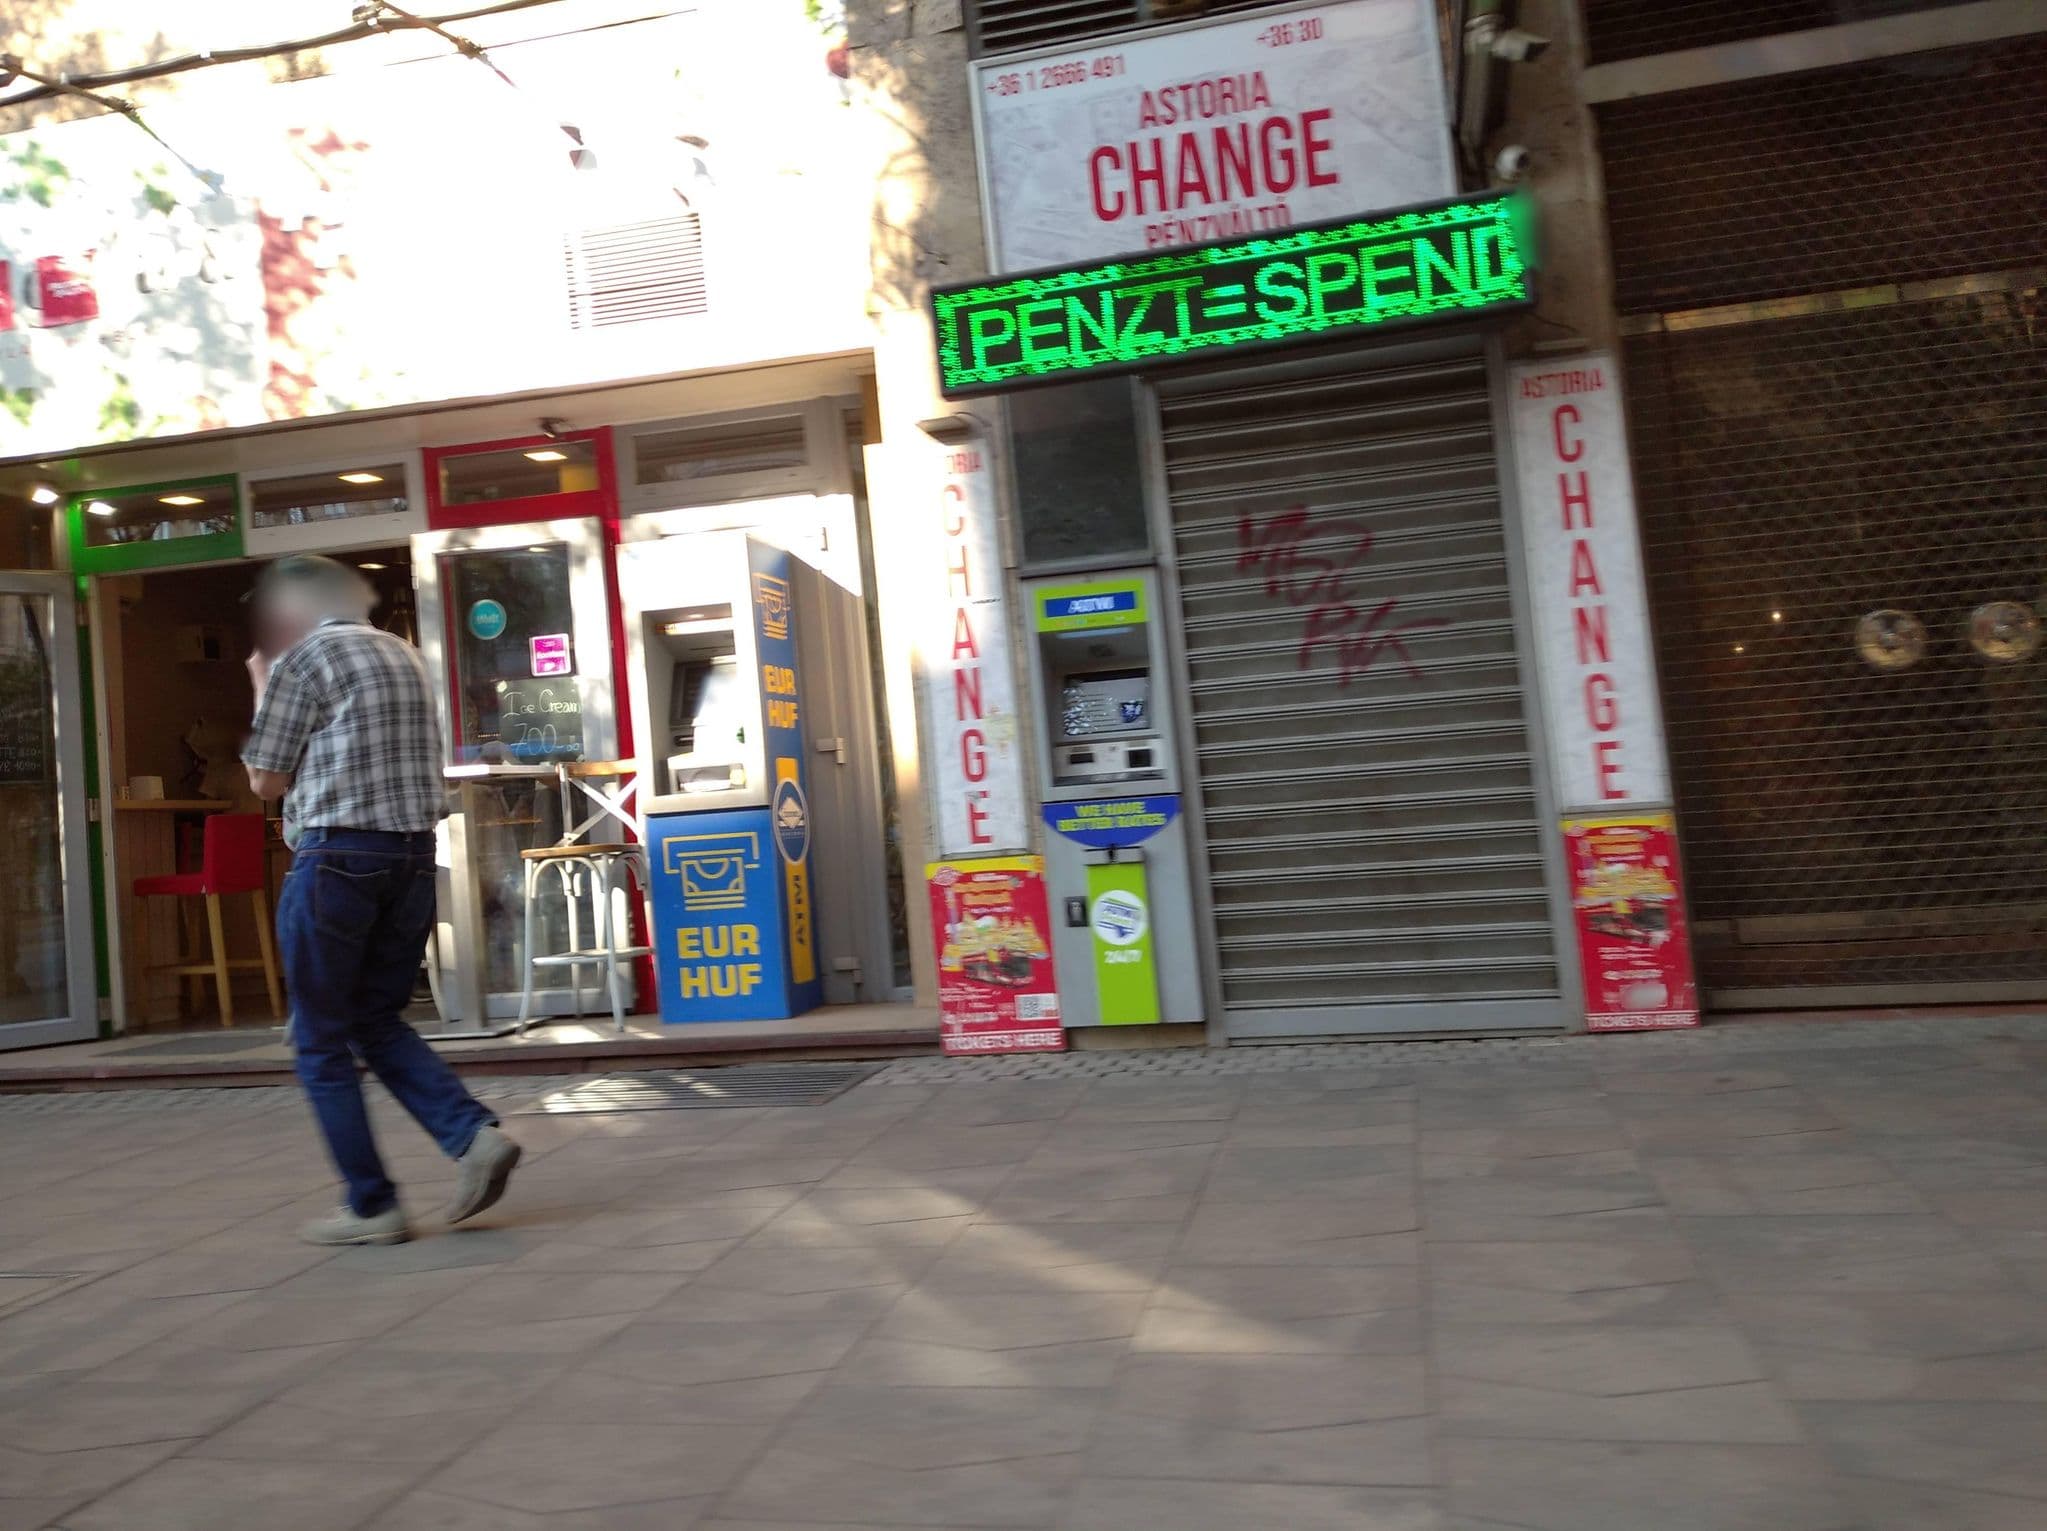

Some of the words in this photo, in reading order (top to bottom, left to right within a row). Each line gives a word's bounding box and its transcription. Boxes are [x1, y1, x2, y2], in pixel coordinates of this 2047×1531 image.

[1026, 70, 1037, 90] 1
[1140, 71, 1272, 129] ASTORIA
[1089, 107, 1341, 222] CHANGE
[1522, 368, 1606, 399] ASTORIA
[1551, 403, 1630, 801] CHANGE
[763, 664, 797, 695] EUR
[942, 484, 995, 846] CHANGE
[503, 691, 536, 718] Ice
[767, 699, 799, 729] HUF
[677, 924, 760, 958] EUR
[680, 963, 762, 998] HUF
